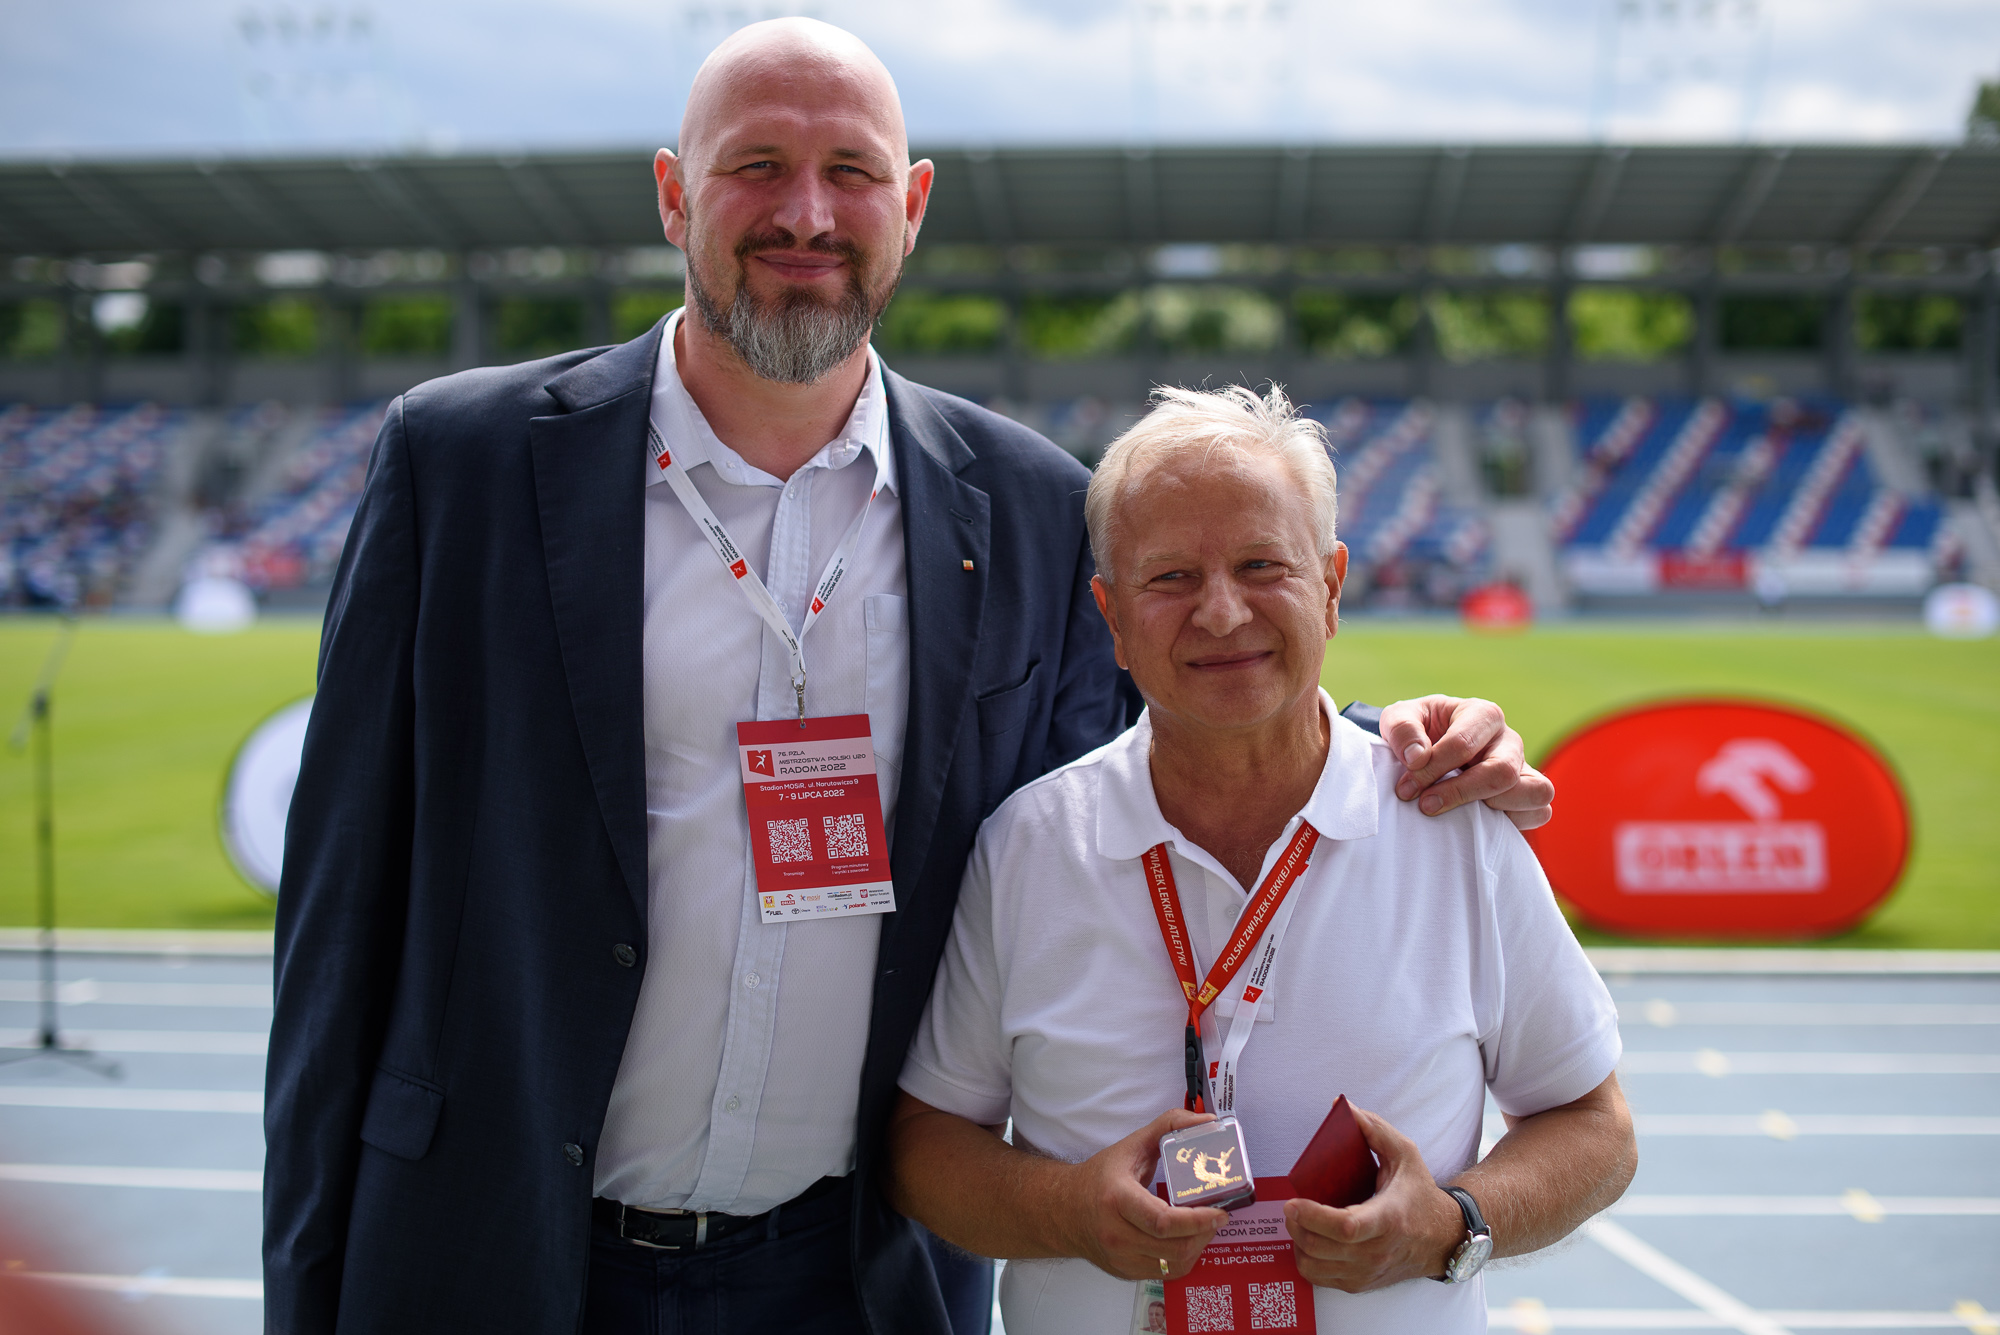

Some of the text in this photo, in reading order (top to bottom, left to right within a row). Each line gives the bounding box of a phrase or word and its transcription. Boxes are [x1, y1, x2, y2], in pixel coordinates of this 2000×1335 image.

[714, 525, 739, 559] RADOM 2022
[823, 568, 844, 602] RADOM 2022
[779, 757, 826, 765] MISTRZOSTWA
[780, 763, 846, 775] RADOM 2022
[816, 779, 854, 787] Narutowicza
[797, 791, 823, 800] LIPCA
[823, 789, 845, 798] 2022
[1222, 826, 1313, 973] POLSKI ZWIĄZEK LEKKIEJ ATLETYKI
[1158, 887, 1176, 923] LEKKIEJ
[1168, 923, 1188, 966] ATLETYKI
[1259, 947, 1276, 987] RADOM 2022
[1204, 1181, 1217, 1191] dla
[1215, 1226, 1278, 1237] ADOM 2022
[1243, 1244, 1285, 1252] Narutowicza
[1201, 1258, 1206, 1266] 7
[1214, 1257, 1221, 1265] 9
[1221, 1256, 1249, 1265] LIPCA
[1250, 1254, 1275, 1263] 2022
